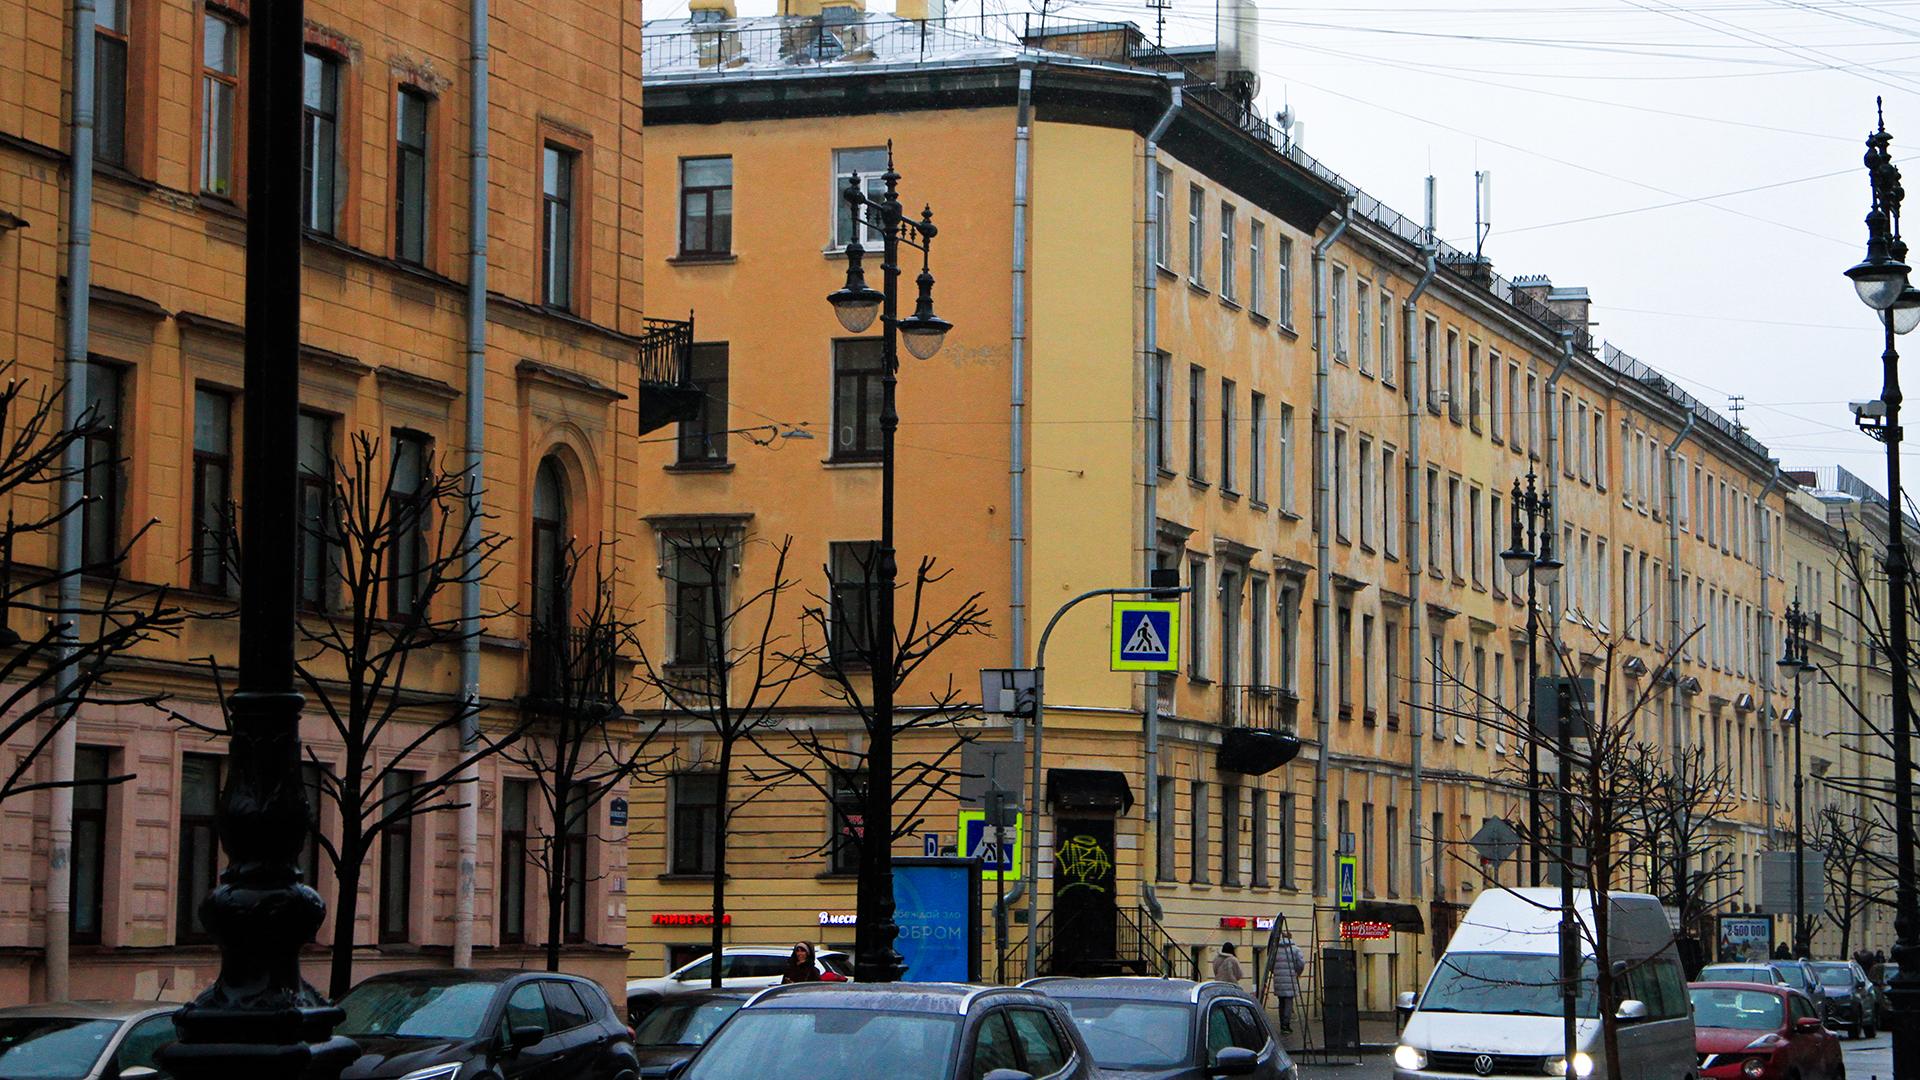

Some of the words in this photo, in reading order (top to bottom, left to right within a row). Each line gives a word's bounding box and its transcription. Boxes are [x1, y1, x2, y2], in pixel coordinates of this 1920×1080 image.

[898, 925, 961, 940] ОБРОМ
[1733, 925, 1749, 937] 500
[1750, 925, 1766, 937] 000
